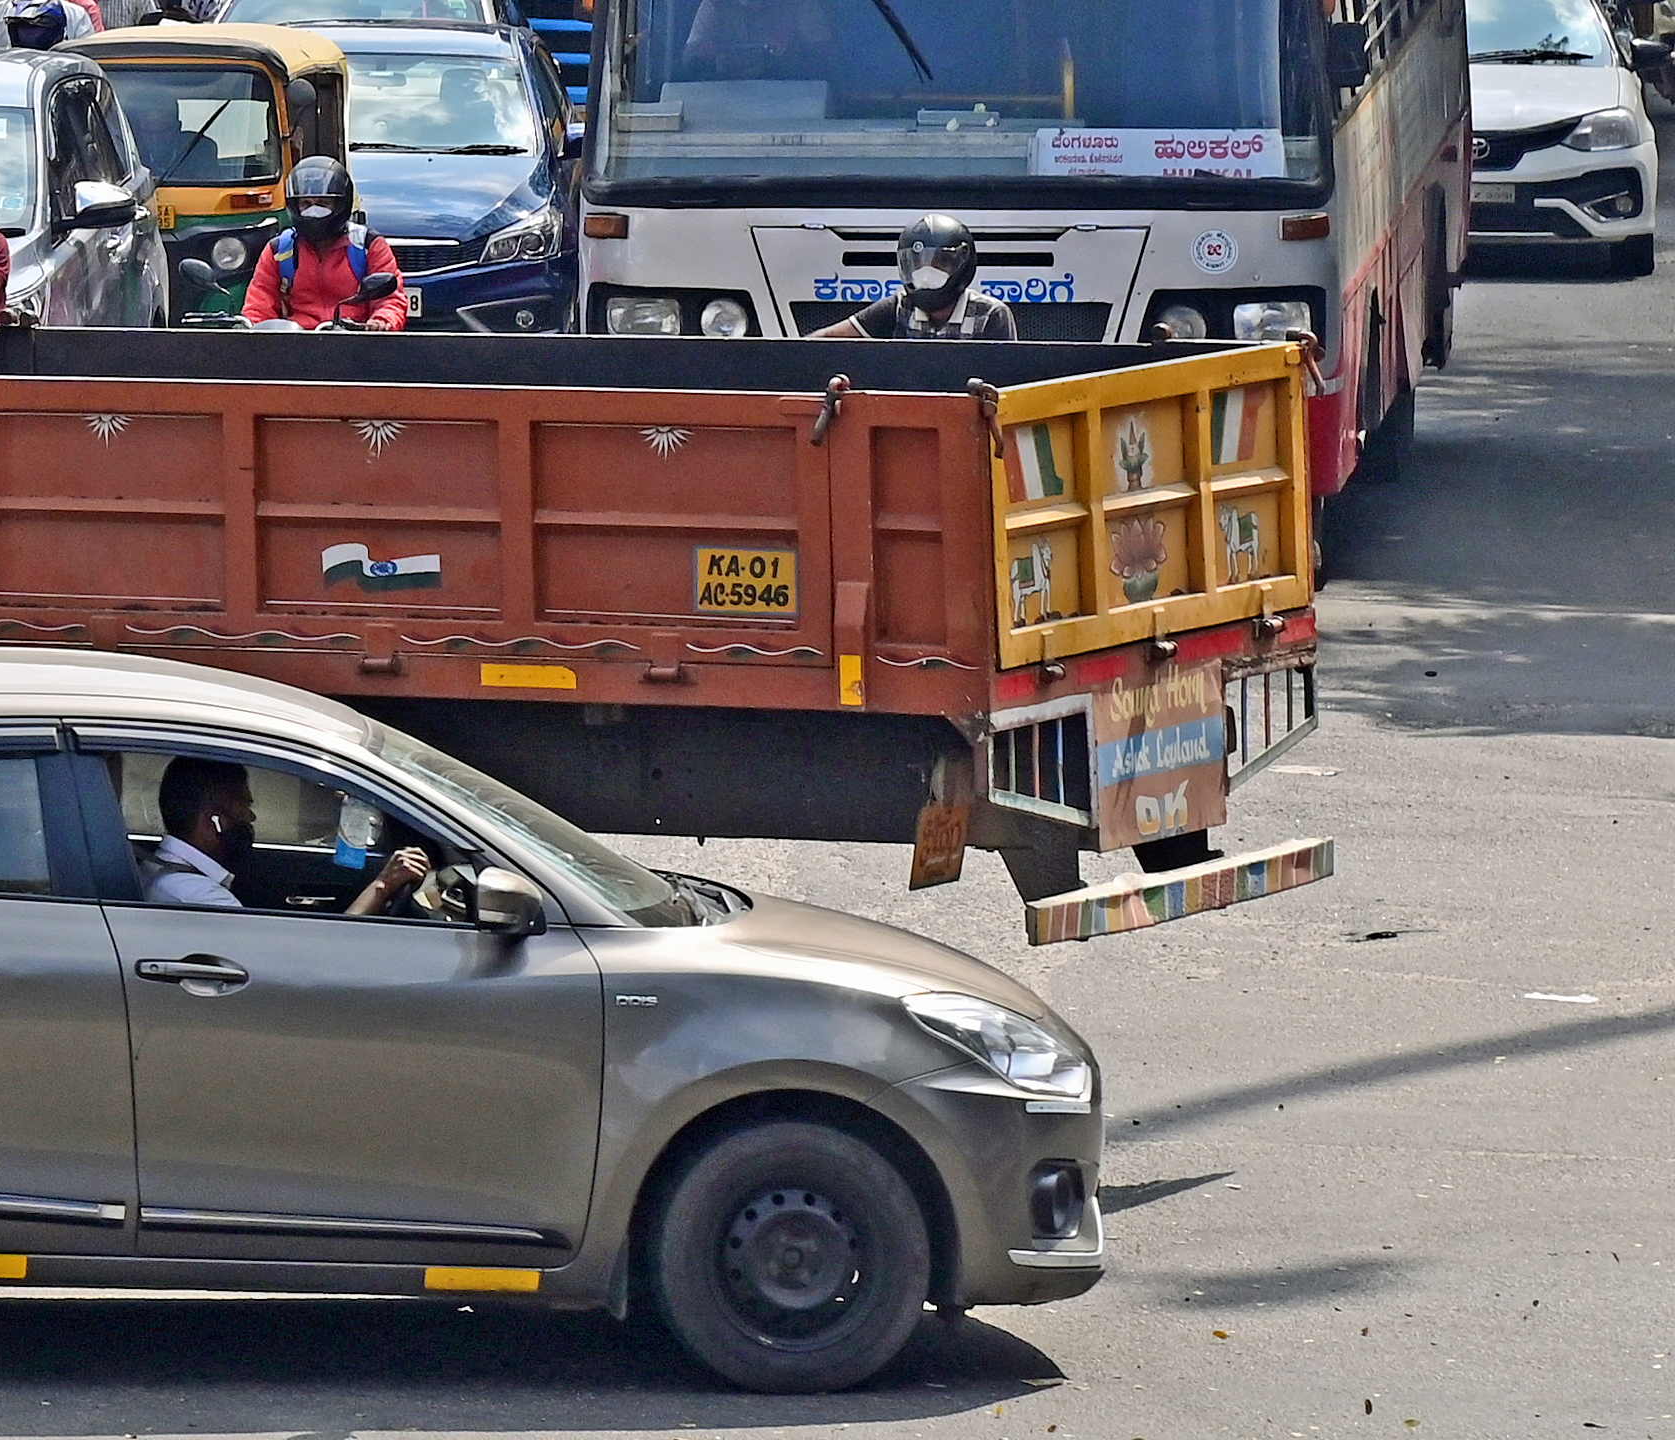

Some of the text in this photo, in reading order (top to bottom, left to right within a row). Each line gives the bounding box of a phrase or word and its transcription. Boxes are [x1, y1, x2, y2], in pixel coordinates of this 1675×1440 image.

[1154, 133, 1263, 160] ಹುಲಿಕಲ್
[980, 272, 1074, 302] ಸಾರಿಗೆ
[1109, 666, 1208, 728] Sound Horn
[1111, 723, 1210, 779] Ashok Leyland
